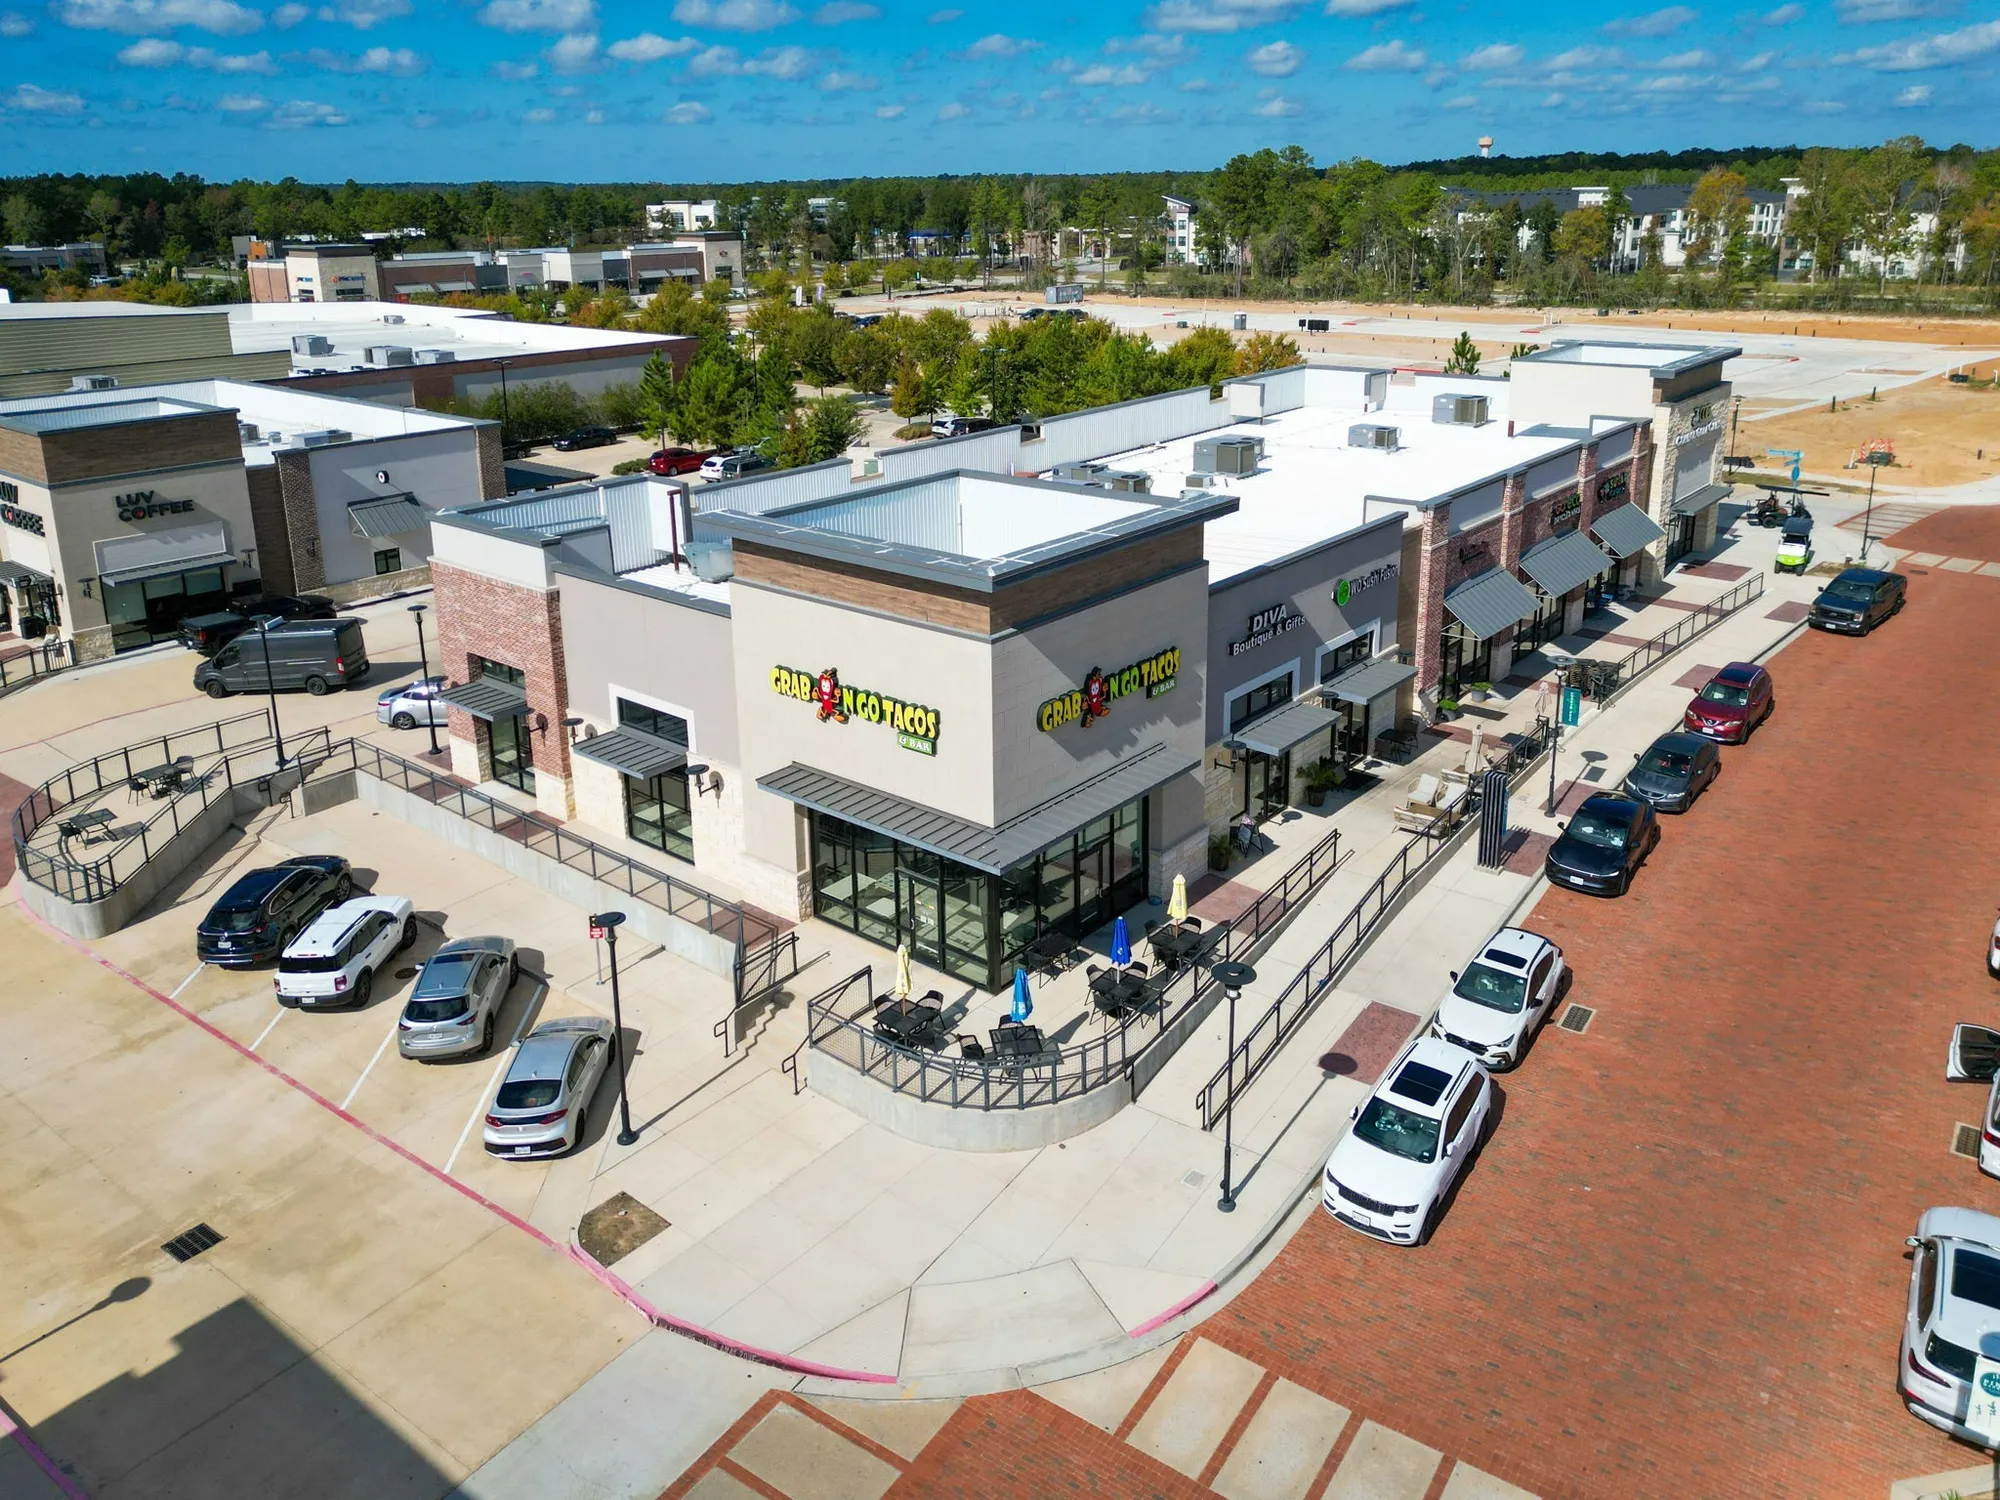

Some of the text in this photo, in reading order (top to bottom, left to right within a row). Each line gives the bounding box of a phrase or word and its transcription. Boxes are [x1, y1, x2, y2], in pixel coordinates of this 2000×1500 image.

[115, 490, 155, 508] LUV
[118, 499, 195, 522] COFFEE
[1363, 570, 1380, 590] Sushi
[1252, 604, 1287, 632] DIVA
[1233, 615, 1306, 657] Boutique & Gifts
[1042, 649, 1180, 732] GRAB N GO TACOS
[1160, 679, 1175, 693] BAR
[769, 666, 937, 738] GRAB N GO TACOS
[909, 737, 930, 751] BAR
